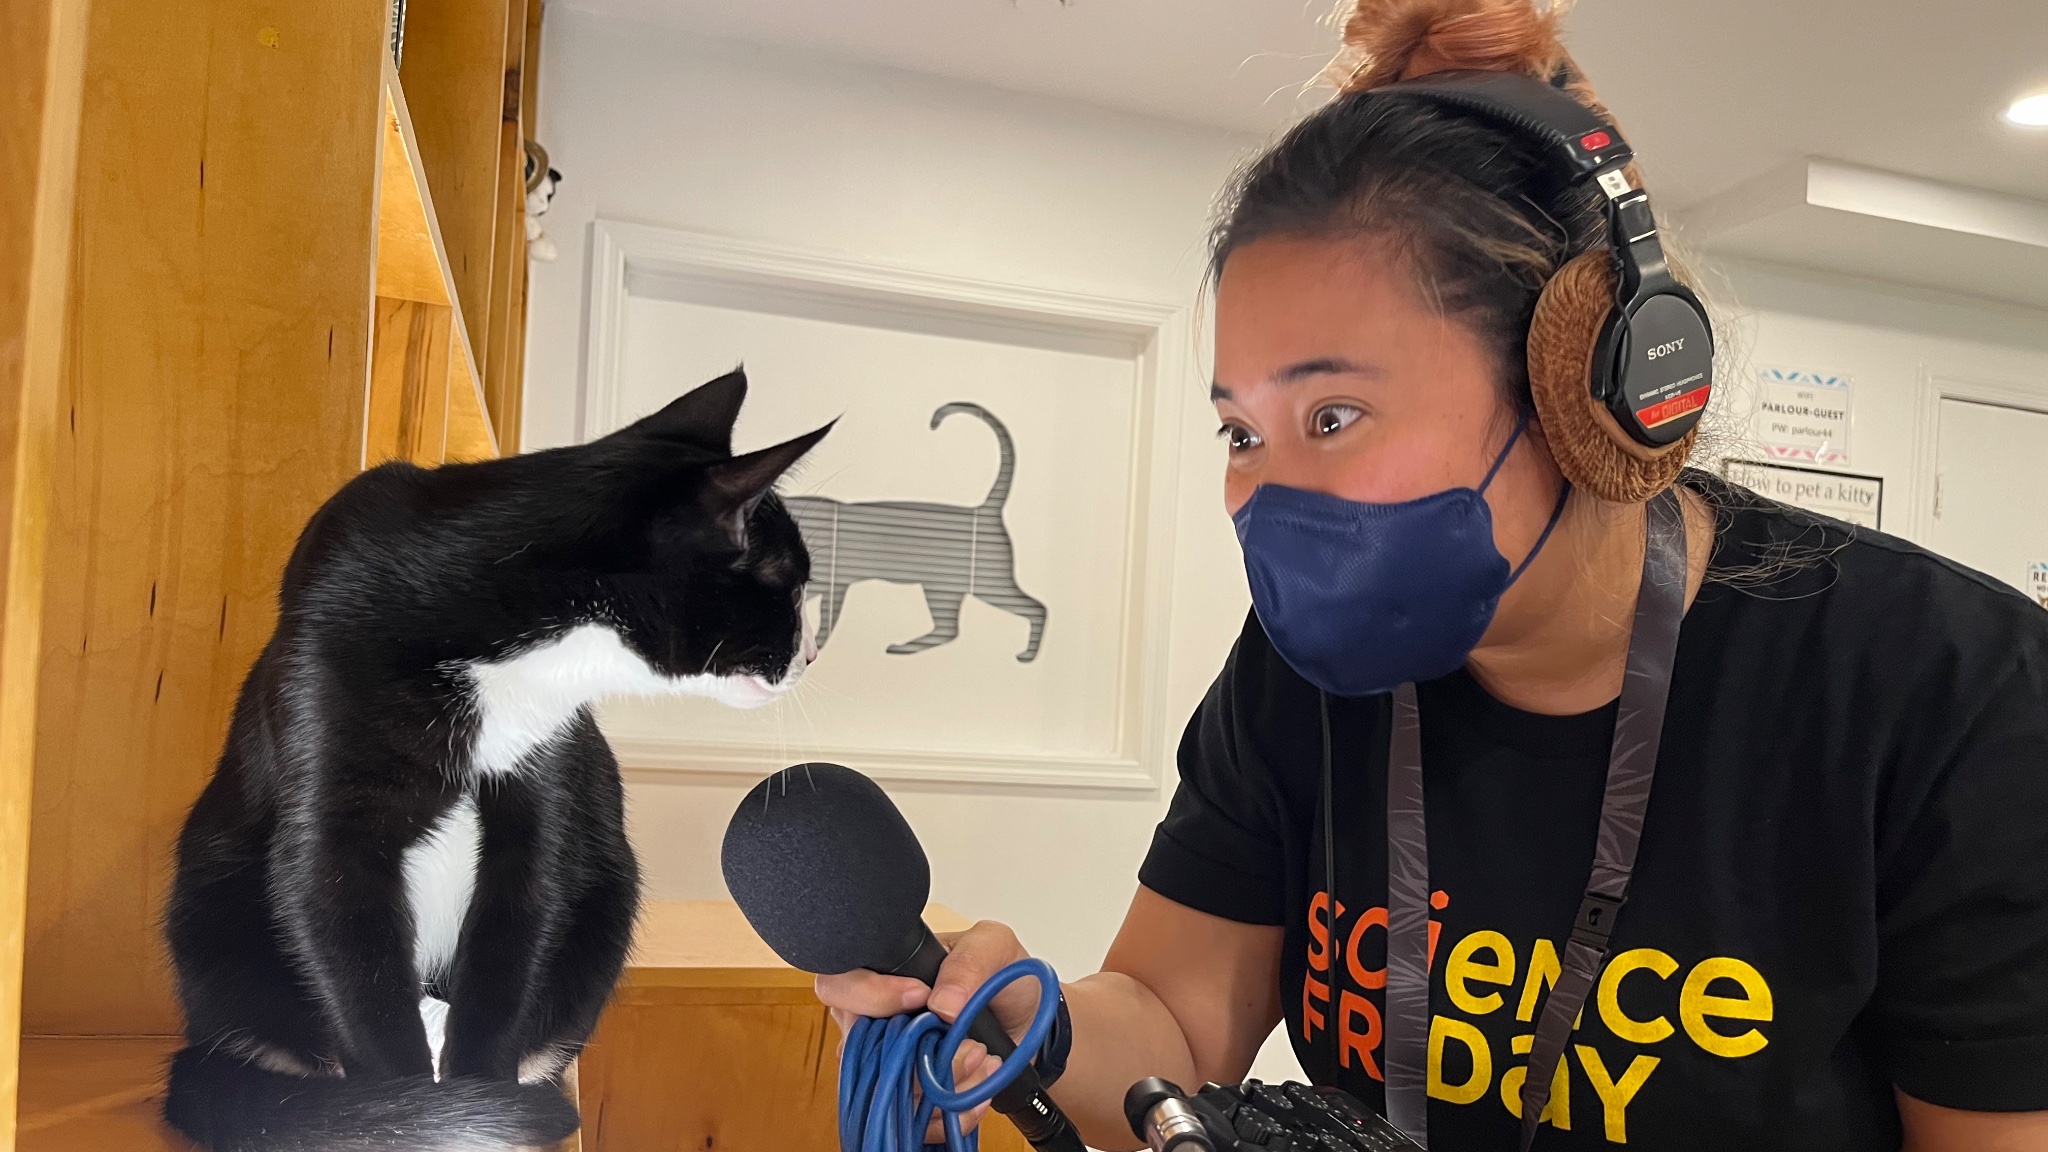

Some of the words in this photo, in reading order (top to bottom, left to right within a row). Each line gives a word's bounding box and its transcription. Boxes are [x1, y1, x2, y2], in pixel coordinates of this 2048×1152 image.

[1647, 338, 1685, 360] SONY
[1661, 395, 1698, 419] DIGITAL
[1761, 401, 1844, 420] PARLOUR-GUEST
[1776, 477, 1792, 494] to
[1795, 481, 1821, 500] pet
[1824, 486, 1833, 500] a
[1838, 482, 1875, 506] kitty
[1303, 969, 1661, 1144] FRDaY
